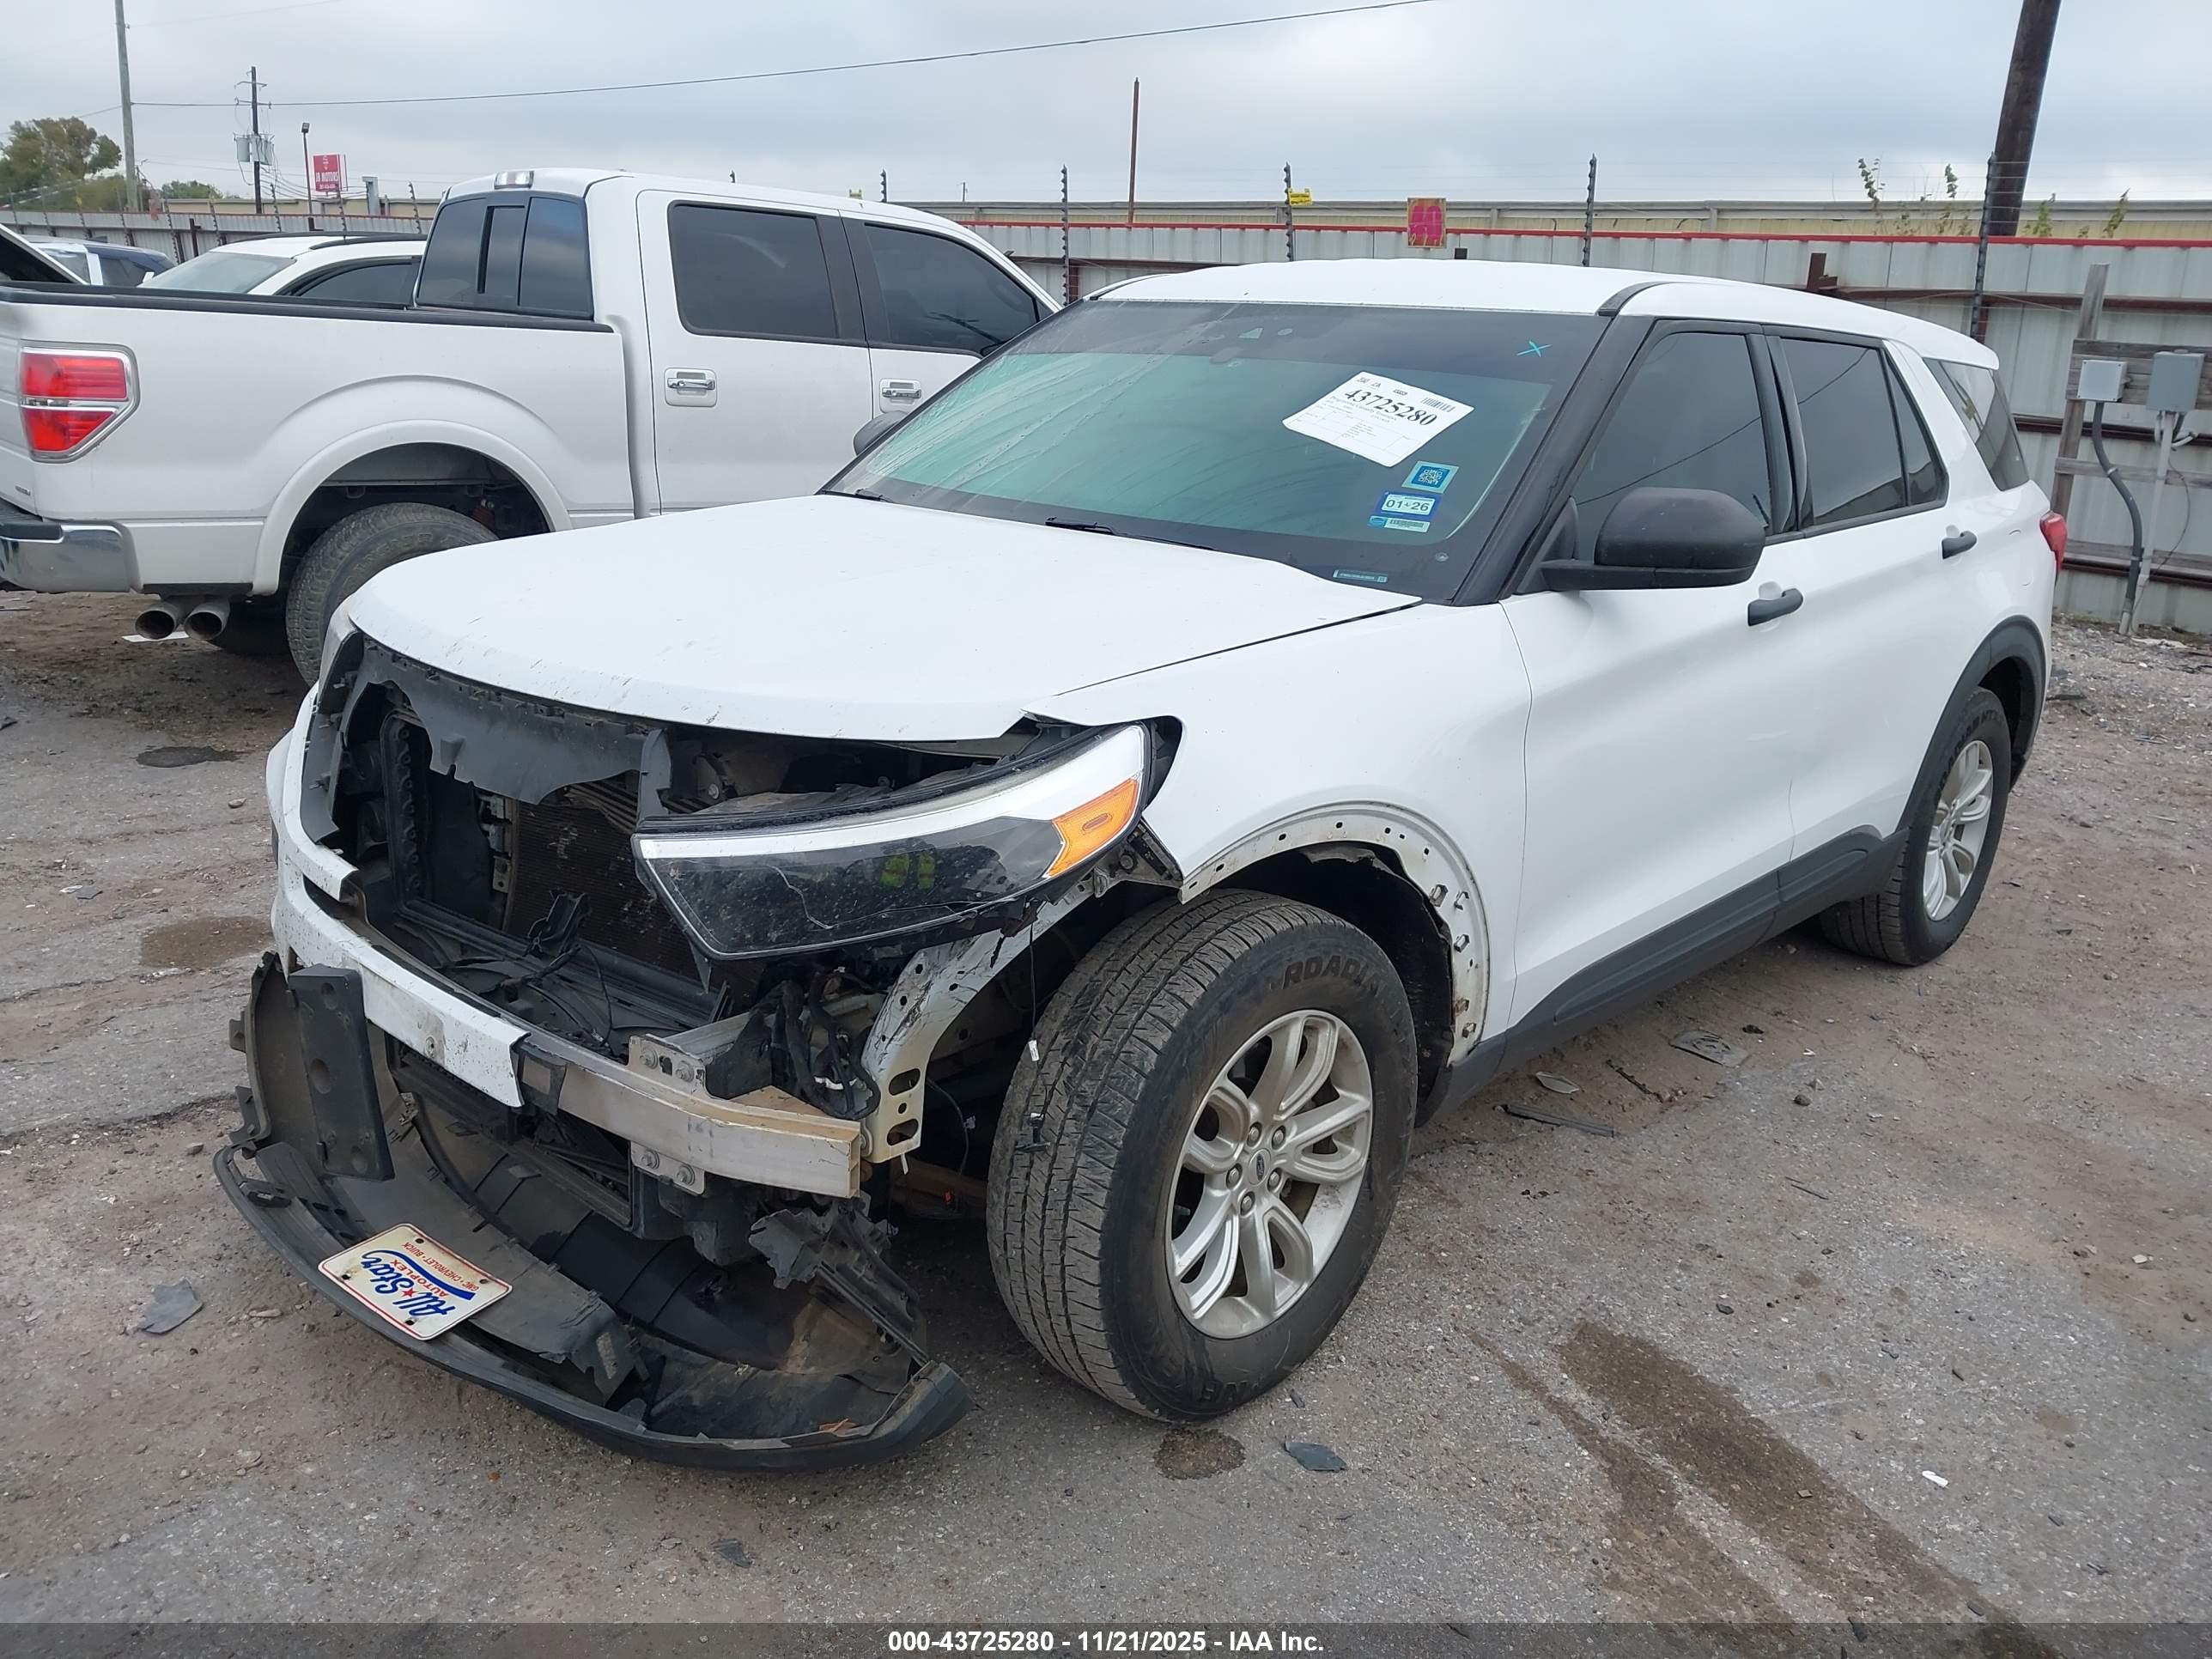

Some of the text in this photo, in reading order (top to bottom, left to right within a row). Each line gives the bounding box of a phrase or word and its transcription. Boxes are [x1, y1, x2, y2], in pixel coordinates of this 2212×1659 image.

[1345, 389, 1437, 425] 43725280
[1386, 499, 1430, 512] 01 26
[361, 1255, 456, 1316] All Star
[389, 1258, 449, 1297] AUTOPLEX
[401, 1242, 481, 1291] GMC CHEVROLET BUICK
